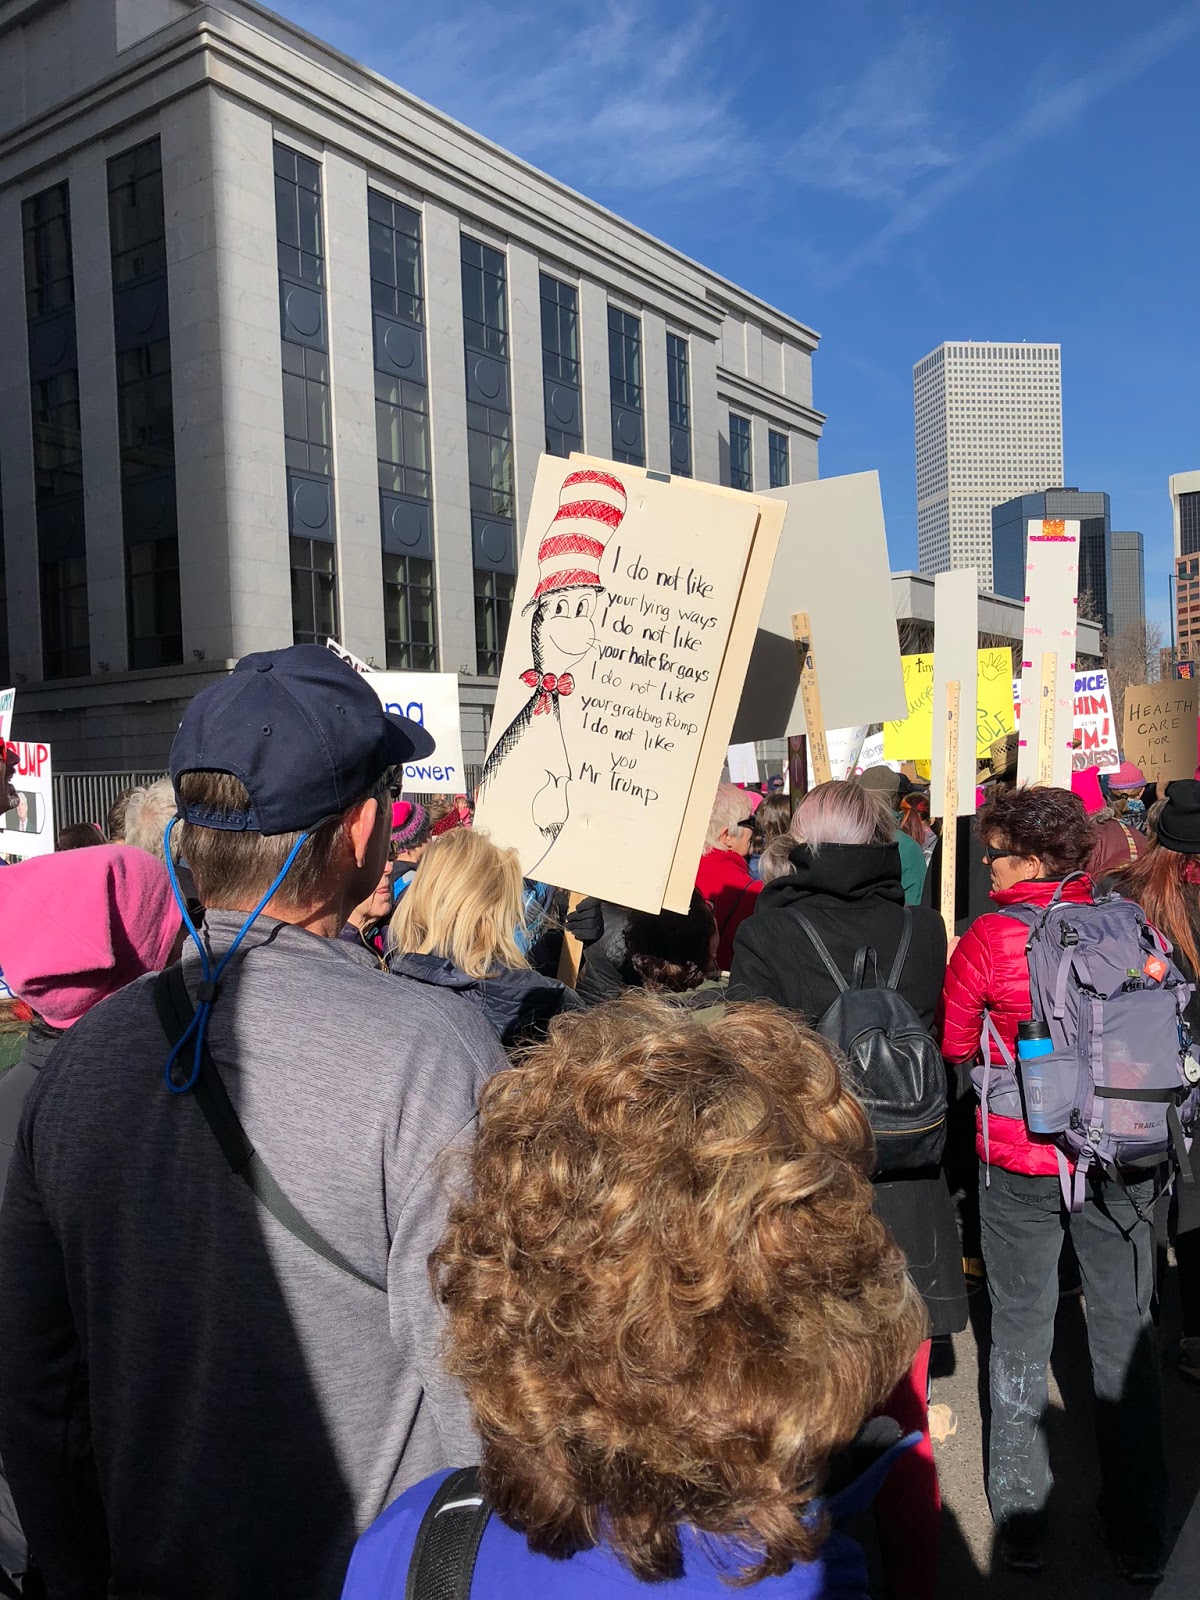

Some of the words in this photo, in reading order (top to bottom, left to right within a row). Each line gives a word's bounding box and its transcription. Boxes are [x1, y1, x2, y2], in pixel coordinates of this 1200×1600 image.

[612, 546, 621, 573] I
[626, 554, 649, 580] do
[656, 566, 684, 590] not
[686, 568, 714, 599] like
[601, 607, 608, 628] I
[612, 615, 634, 635] do
[642, 624, 670, 644] not
[673, 625, 702, 651] like
[608, 592, 638, 608] your
[640, 594, 670, 622] lying
[678, 610, 718, 630] ways
[591, 660, 597, 680] I
[600, 669, 622, 688] do
[630, 680, 657, 694] not
[660, 682, 696, 703] like
[598, 644, 629, 660] your
[628, 646, 657, 669] hate
[658, 652, 678, 672] for
[676, 664, 710, 682] gays
[580, 696, 614, 712] your
[610, 702, 662, 728] grabbing
[664, 712, 698, 736] Rump
[1130, 700, 1192, 721] HEALTH
[1137, 718, 1180, 734] CARE
[582, 712, 588, 729] I
[590, 717, 608, 735] do
[614, 728, 636, 742] not
[644, 730, 675, 752] like
[1148, 736, 1170, 747] FOR
[401, 766, 456, 782] ower
[610, 752, 638, 771] you
[1136, 752, 1172, 766] ALL
[579, 762, 602, 784] Mr
[610, 770, 659, 806] Trump
